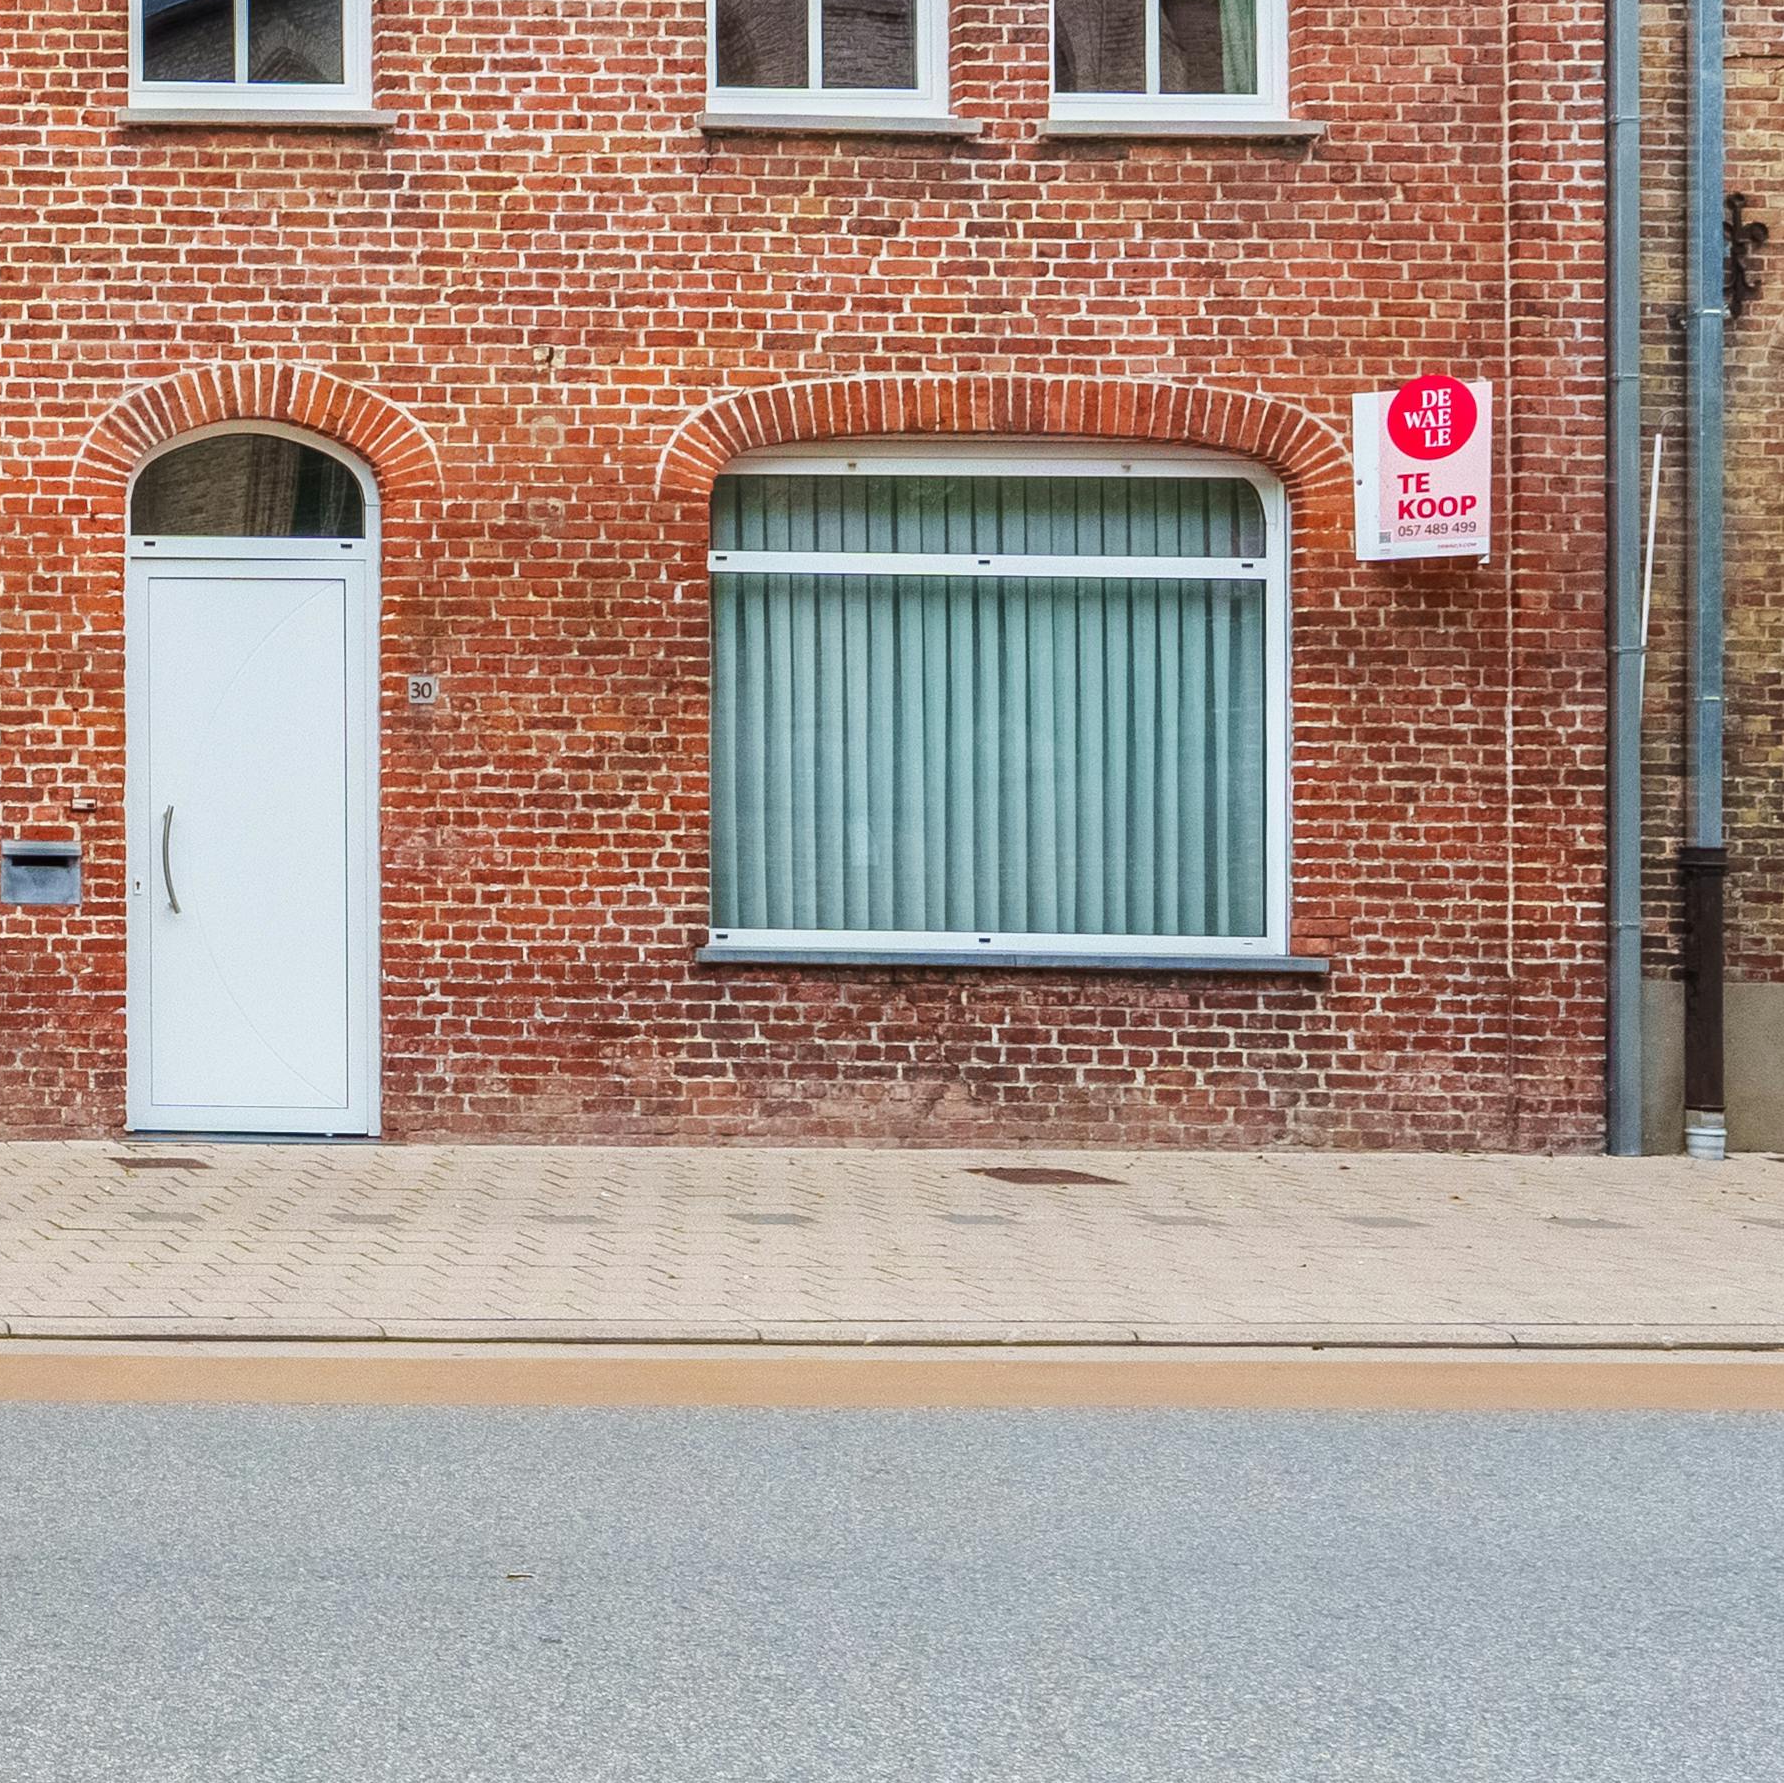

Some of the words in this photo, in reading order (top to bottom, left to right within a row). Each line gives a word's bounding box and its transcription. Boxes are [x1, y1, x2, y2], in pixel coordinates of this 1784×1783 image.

[1421, 388, 1452, 409] DE
[1403, 408, 1452, 429] WAE
[1424, 428, 1452, 448] LE
[1397, 472, 1431, 495] TE
[1398, 495, 1477, 521] KOOP
[1398, 524, 1421, 537] 057
[1424, 522, 1449, 535] 489
[1451, 521, 1477, 533] 499
[409, 681, 432, 699] 30
